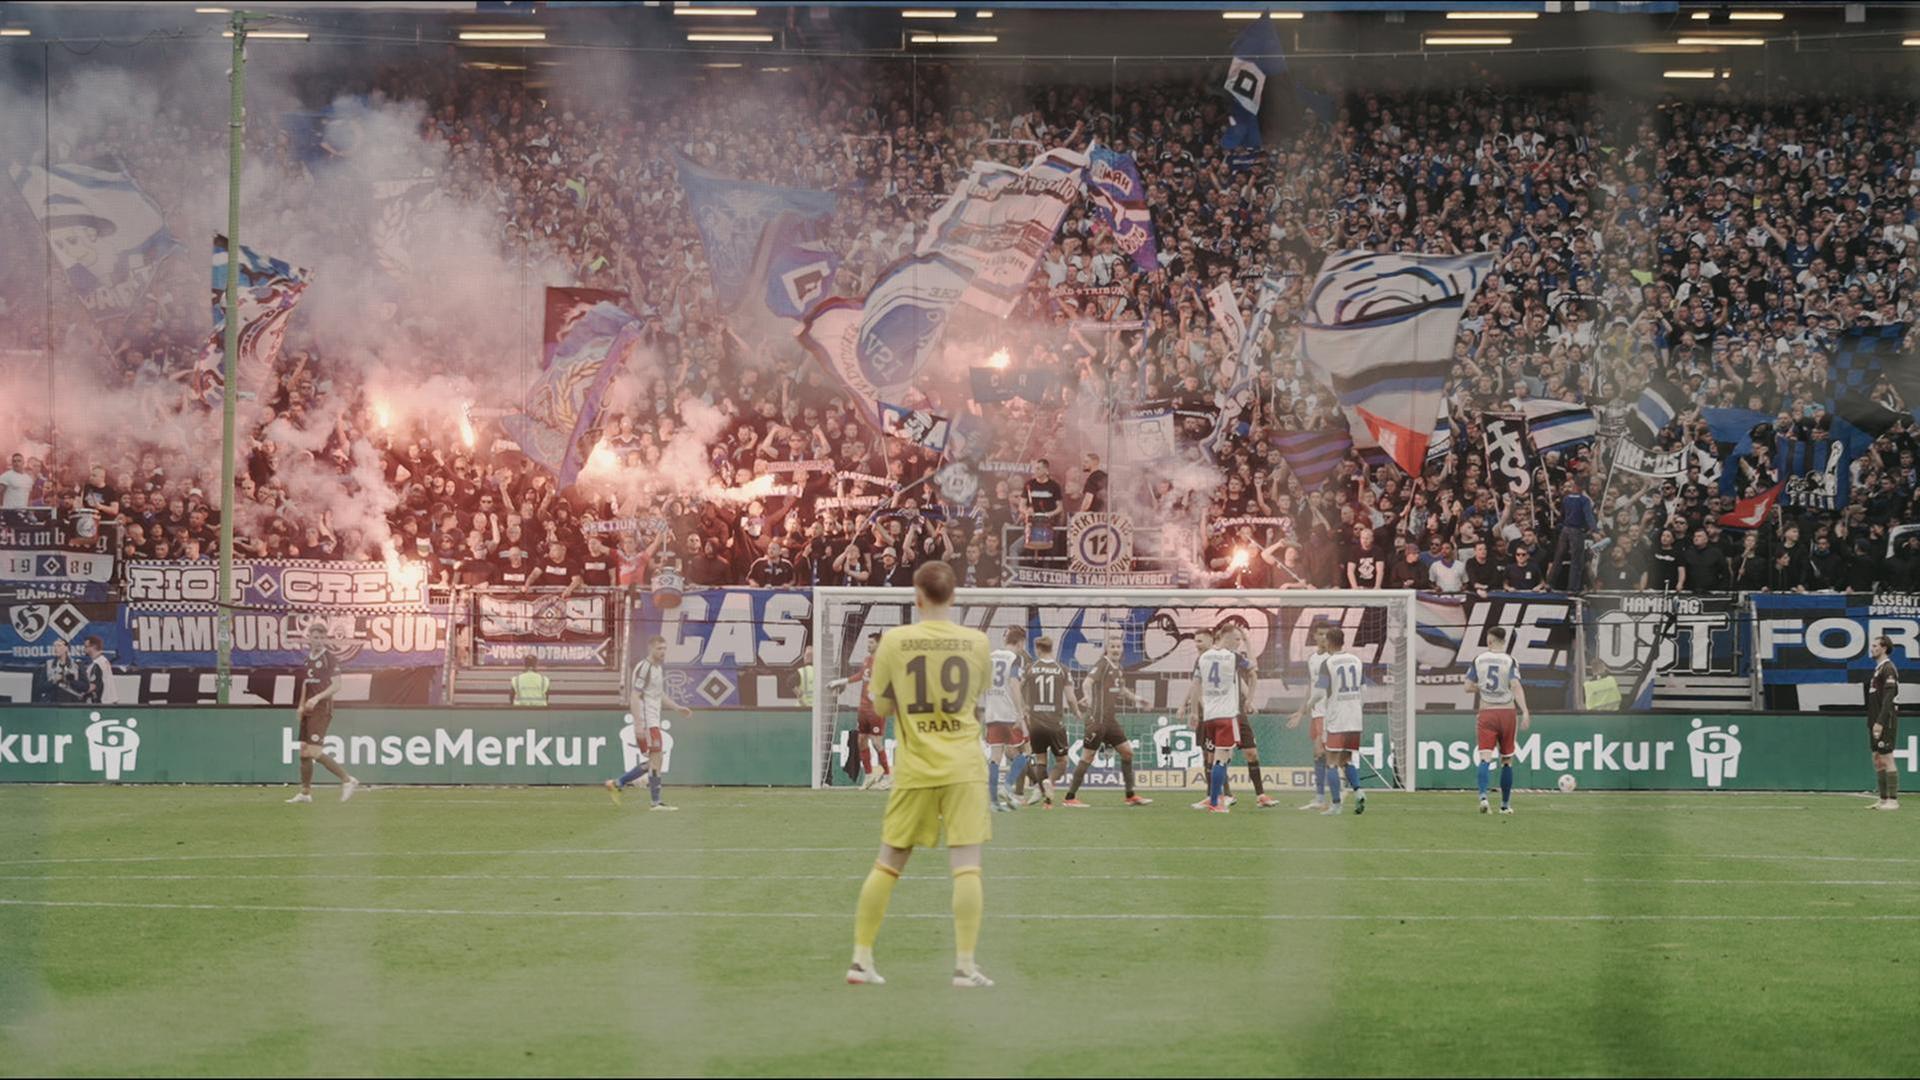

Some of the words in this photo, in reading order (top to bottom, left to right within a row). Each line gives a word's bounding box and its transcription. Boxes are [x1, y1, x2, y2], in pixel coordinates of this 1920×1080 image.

[0, 528, 108, 553] Hambg
[1089, 534, 1108, 556] 12
[129, 566, 252, 602] RIOT
[1018, 569, 1072, 584] SEKTION
[13, 645, 88, 658] HOOLIAN
[1597, 611, 1727, 671] OST
[906, 655, 970, 715] 19
[1034, 674, 1056, 704] 11
[1207, 661, 1222, 689] 4
[1336, 664, 1360, 693] 11
[1486, 665, 1500, 692] 5
[916, 719, 961, 734] RAAB
[282, 727, 606, 767] HanseMerkur
[1351, 732, 1674, 771] HnsMerkur
[1137, 773, 1182, 784] BET
[1191, 771, 1287, 786] AMIAL
